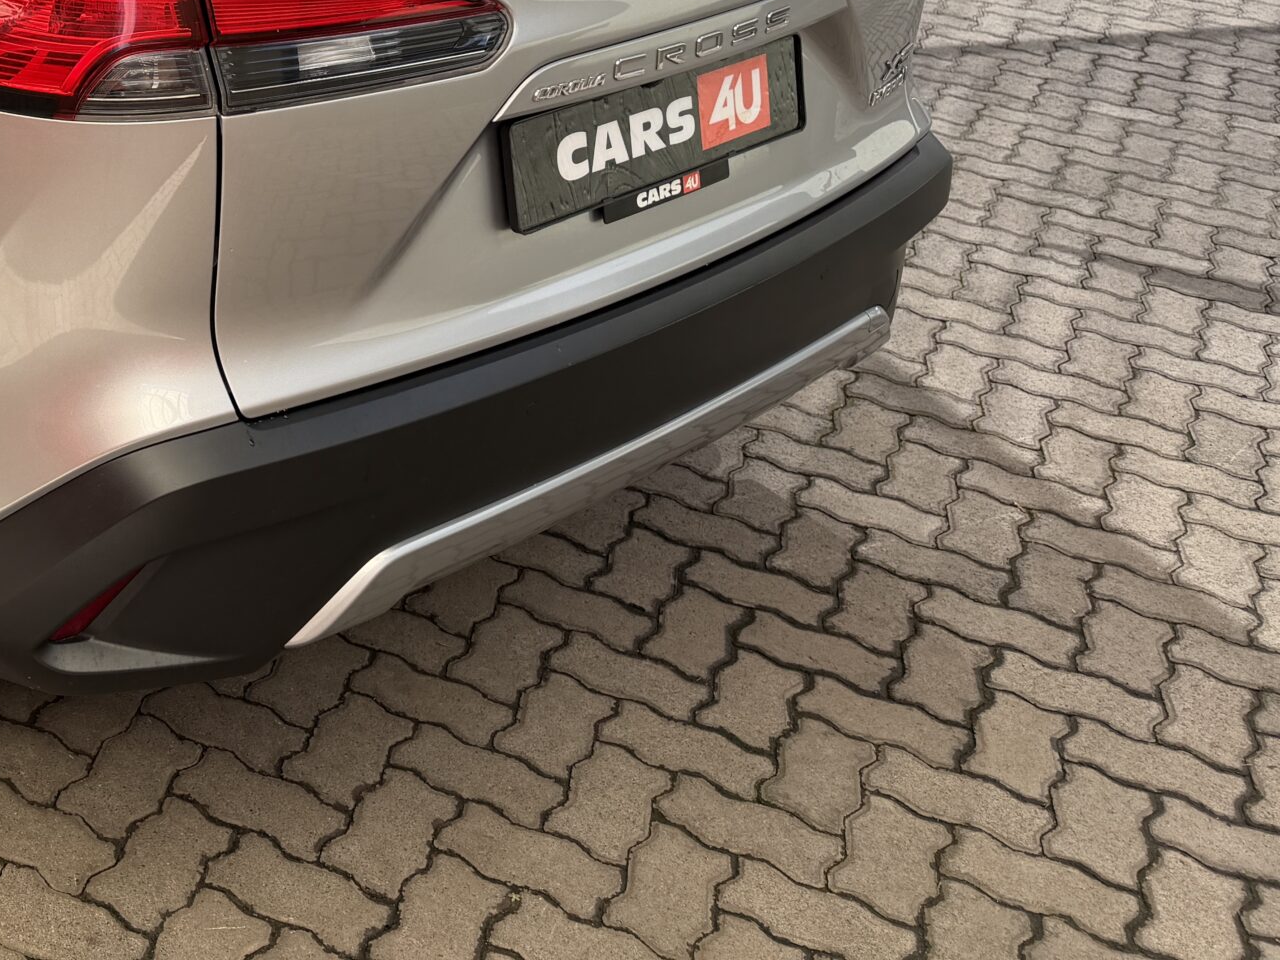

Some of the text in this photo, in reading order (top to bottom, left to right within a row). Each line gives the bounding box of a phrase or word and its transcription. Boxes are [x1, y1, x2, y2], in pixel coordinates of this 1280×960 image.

[533, 6, 792, 102] COROLLA CROSS
[556, 68, 762, 181] CARS 4U
[636, 174, 700, 208] CARS 4U
